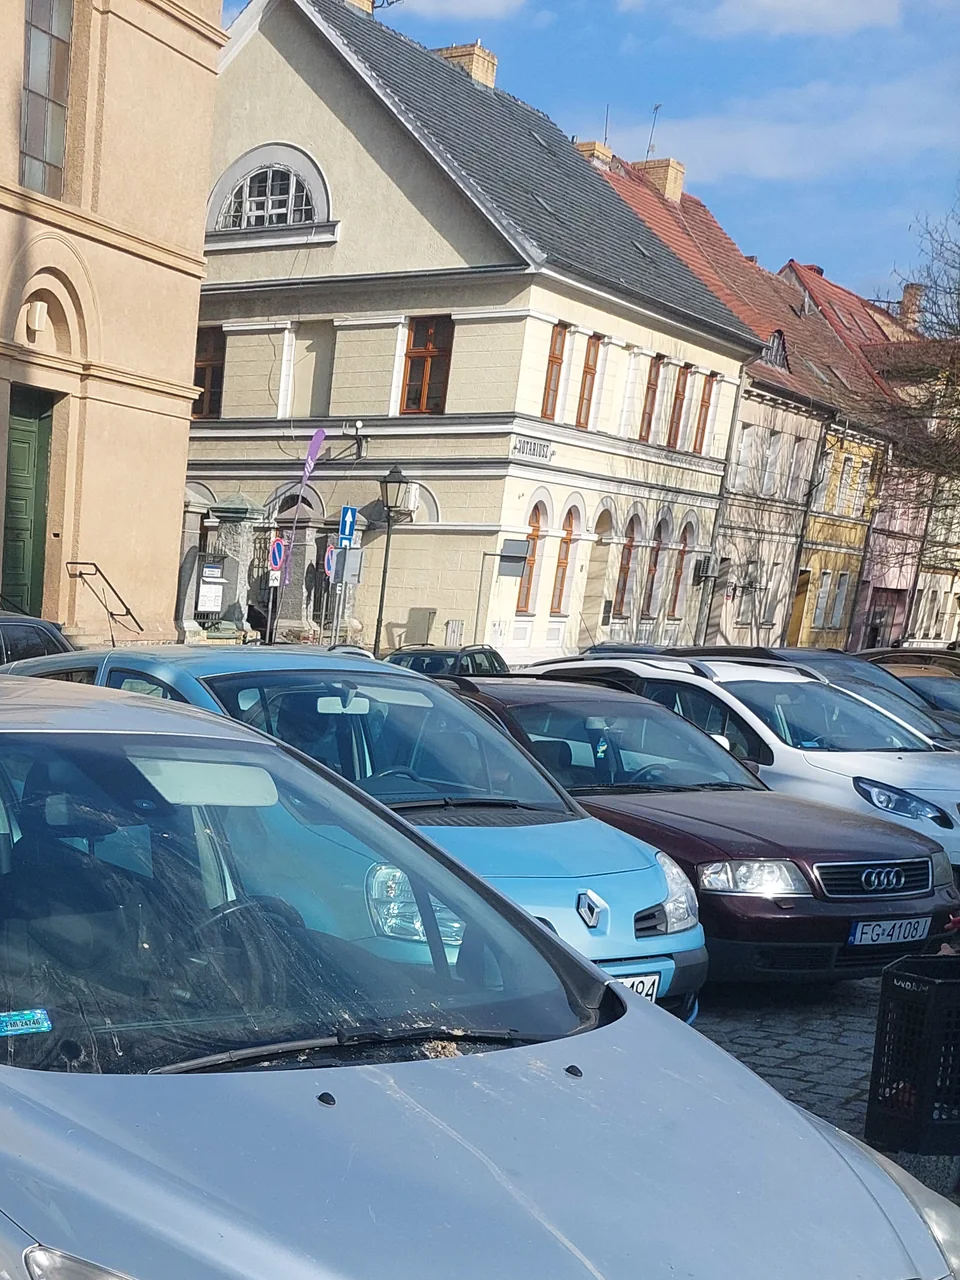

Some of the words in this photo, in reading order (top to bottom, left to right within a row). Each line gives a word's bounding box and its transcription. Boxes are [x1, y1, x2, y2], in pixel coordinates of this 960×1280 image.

[517, 439, 549, 459] NOTARIUSZ
[860, 923, 881, 943] FG
[886, 919, 928, 941] 4108J
